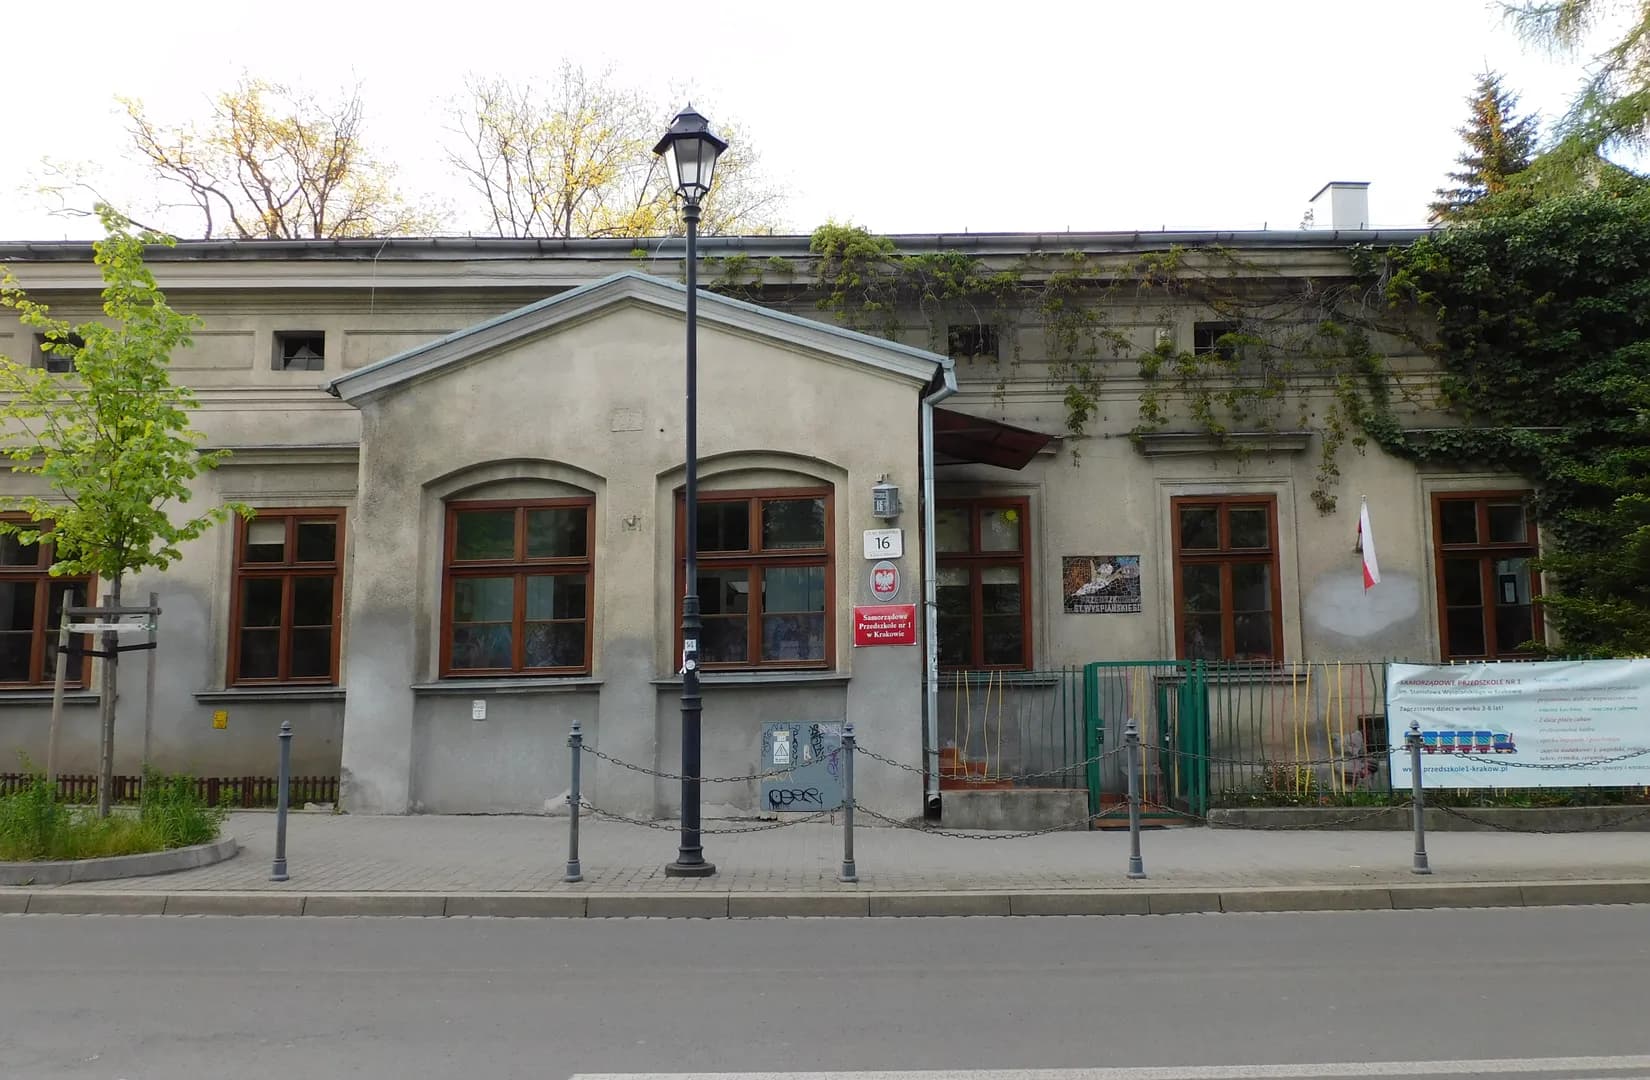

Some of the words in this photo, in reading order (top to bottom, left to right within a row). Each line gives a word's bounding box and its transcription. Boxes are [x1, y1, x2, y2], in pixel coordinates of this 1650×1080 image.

[874, 536, 890, 549] 16
[863, 613, 908, 622] Samorządowe
[859, 622, 897, 630] Przedszkole
[1402, 765, 1508, 773] wwprzedszkole1-krakow.pl
